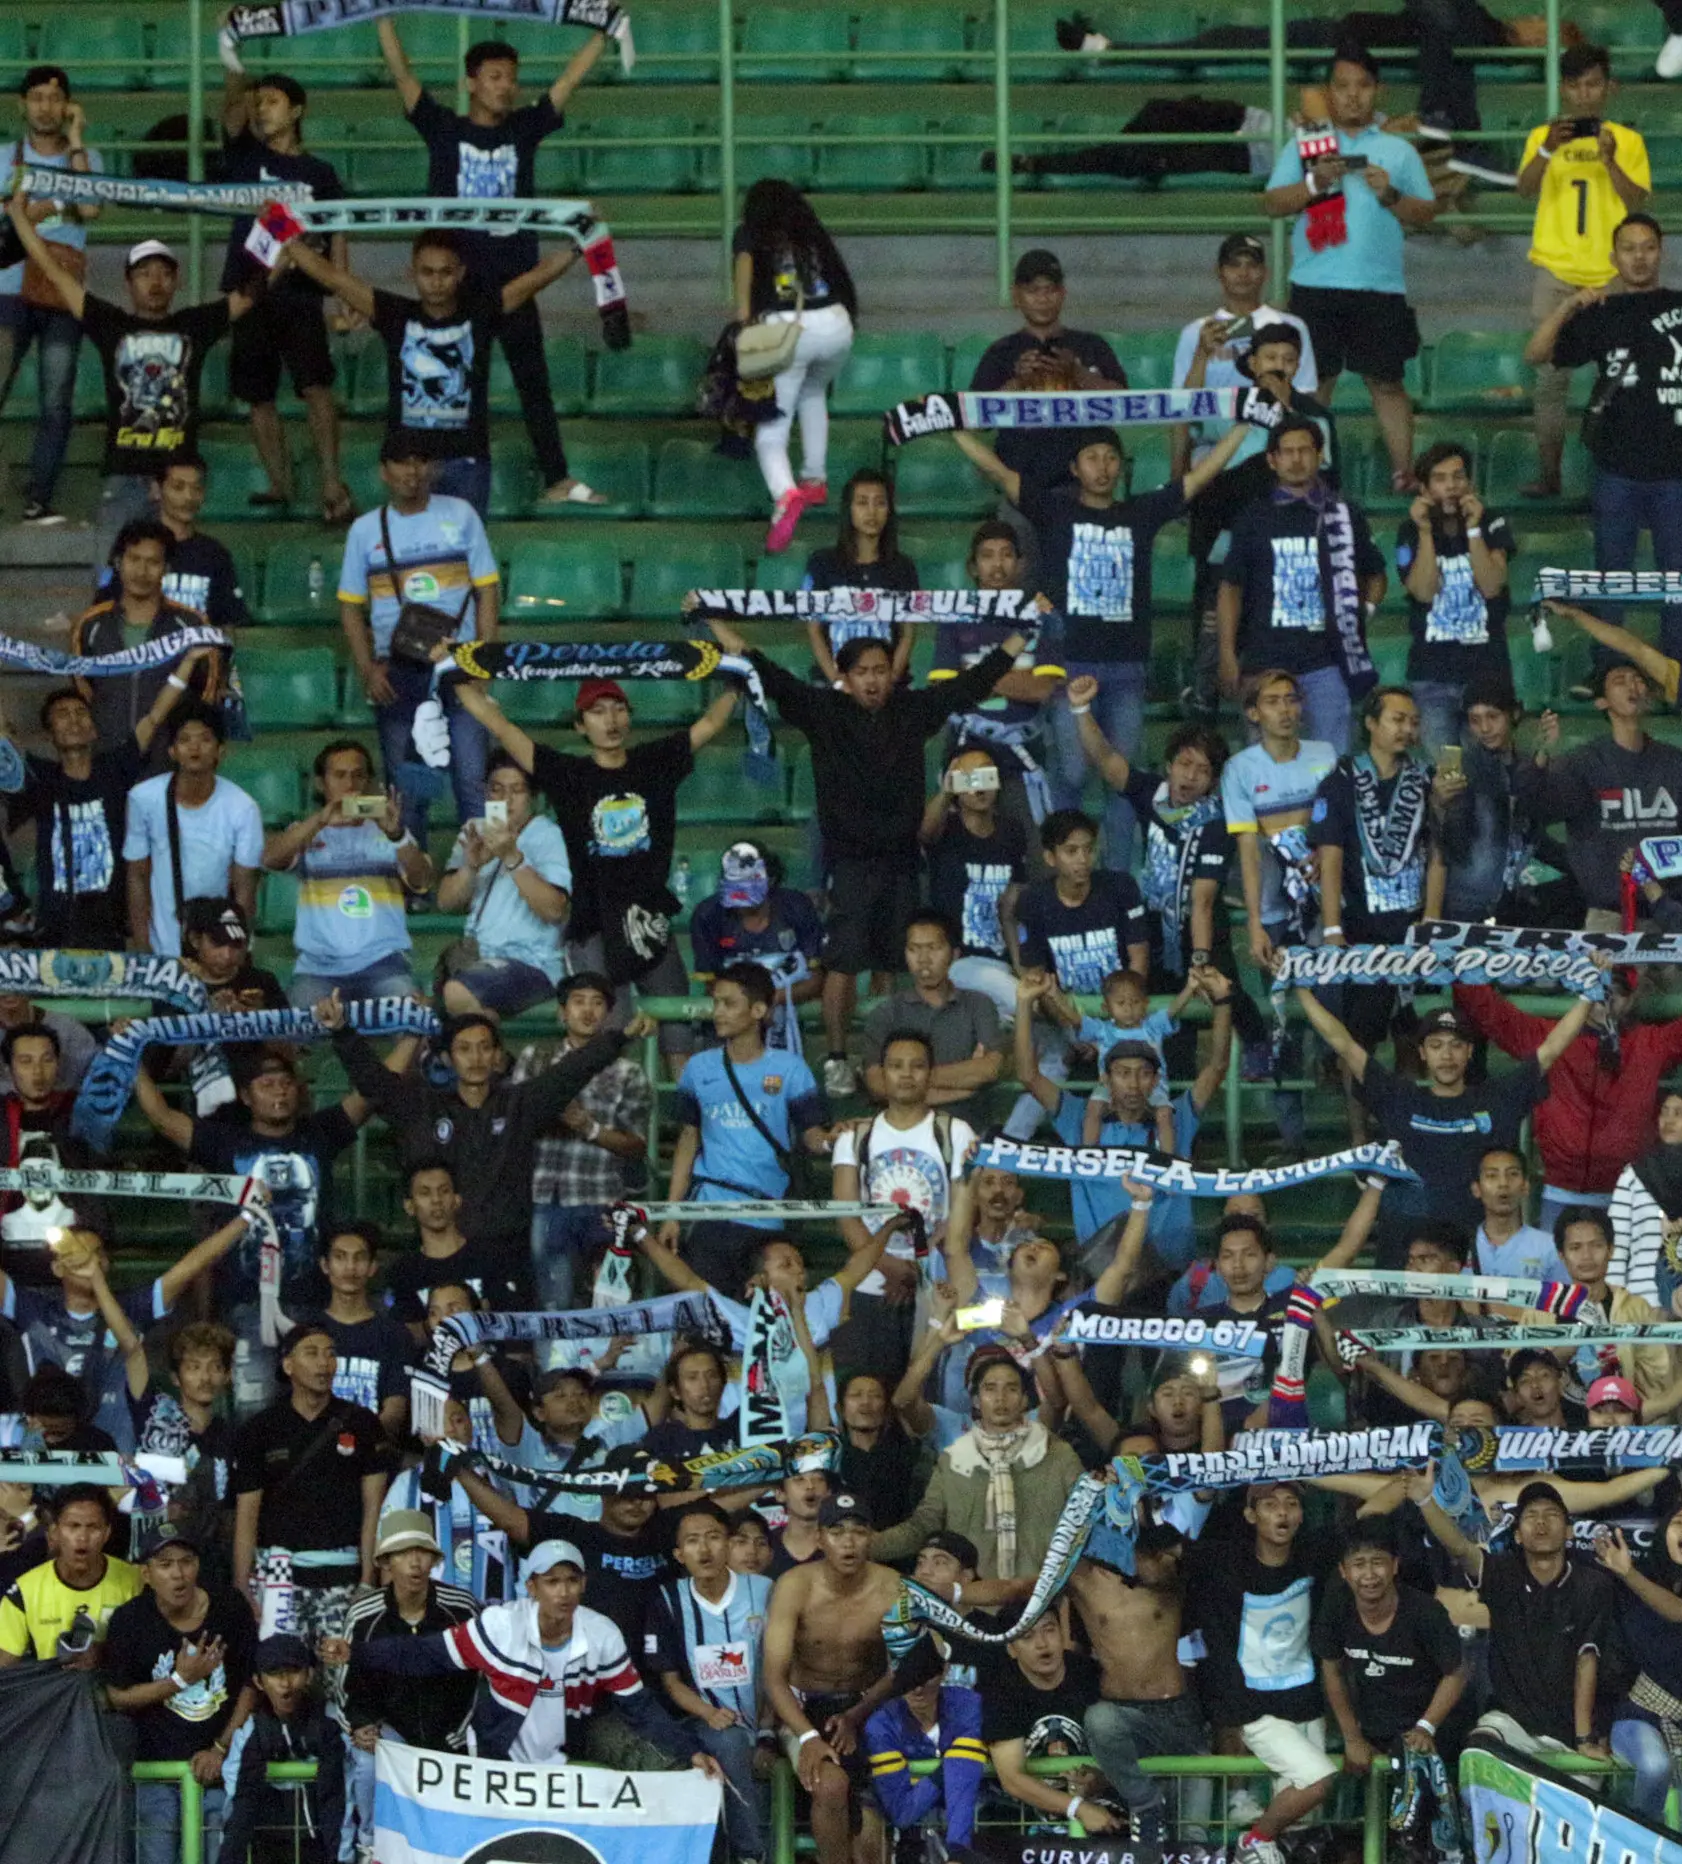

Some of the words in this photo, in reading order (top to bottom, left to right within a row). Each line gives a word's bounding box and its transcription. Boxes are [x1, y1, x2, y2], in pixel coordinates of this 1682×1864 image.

[1571, 179, 1588, 235] 1
[977, 390, 1219, 425] PERSELA
[504, 640, 667, 668] Persela
[1599, 785, 1678, 820] FILA
[1454, 946, 1602, 988] Persela
[987, 1137, 1198, 1191] PERSELA
[1499, 1433, 1596, 1461] WALK
[416, 1756, 643, 1810] PERSELA
